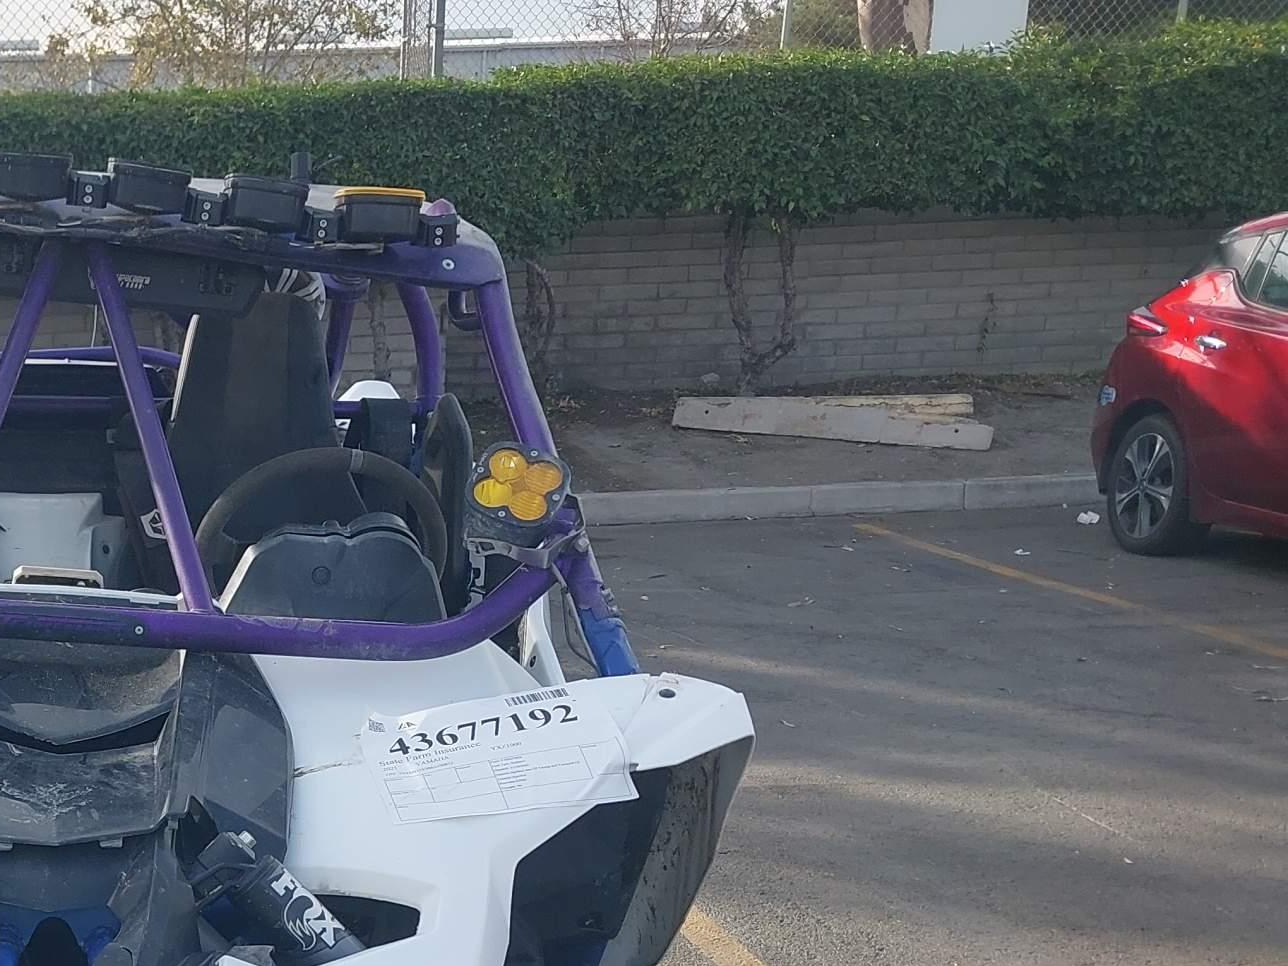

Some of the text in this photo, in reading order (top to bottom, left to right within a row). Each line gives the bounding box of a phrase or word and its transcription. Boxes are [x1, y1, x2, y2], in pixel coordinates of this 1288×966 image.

[388, 703, 579, 756] 43677192
[434, 742, 481, 756] Insurance
[270, 868, 346, 951] FOX
